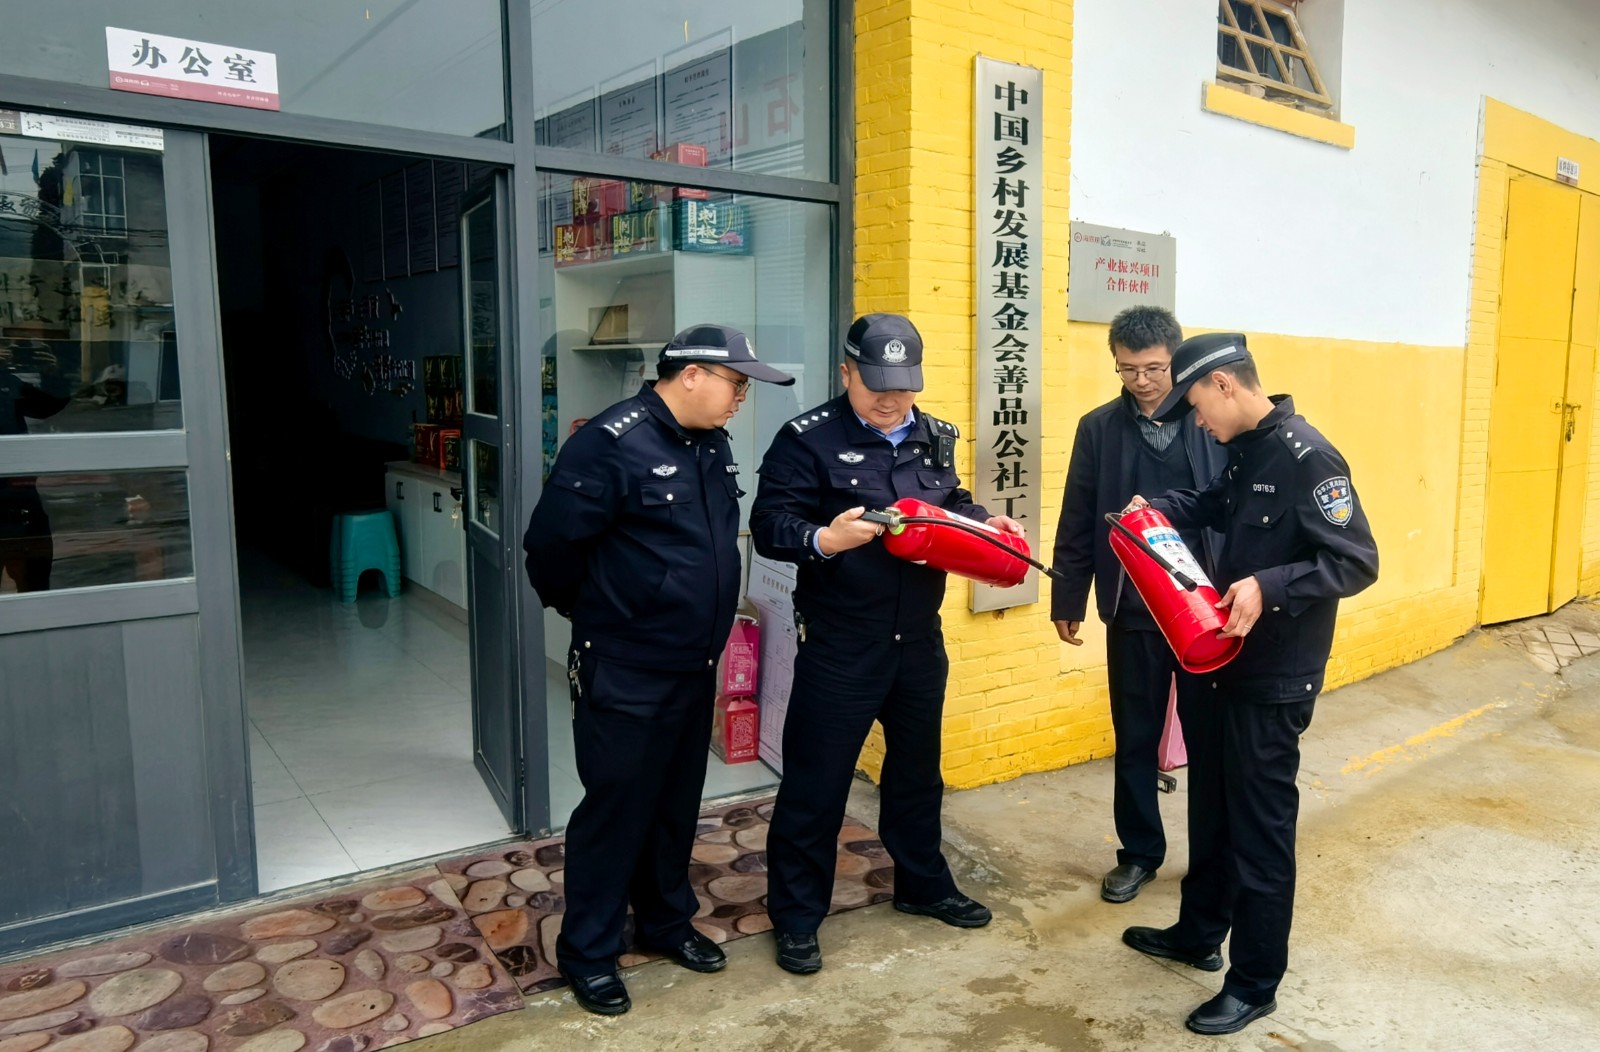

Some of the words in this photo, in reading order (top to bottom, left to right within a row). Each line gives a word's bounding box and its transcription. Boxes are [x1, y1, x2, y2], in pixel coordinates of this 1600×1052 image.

[132, 38, 257, 84] 办公室
[1095, 257, 1159, 278] 产业振兴项目
[1106, 276, 1149, 294] 合作伙伴
[991, 81, 1029, 587] 中国乡村发展基金会善品公社工
